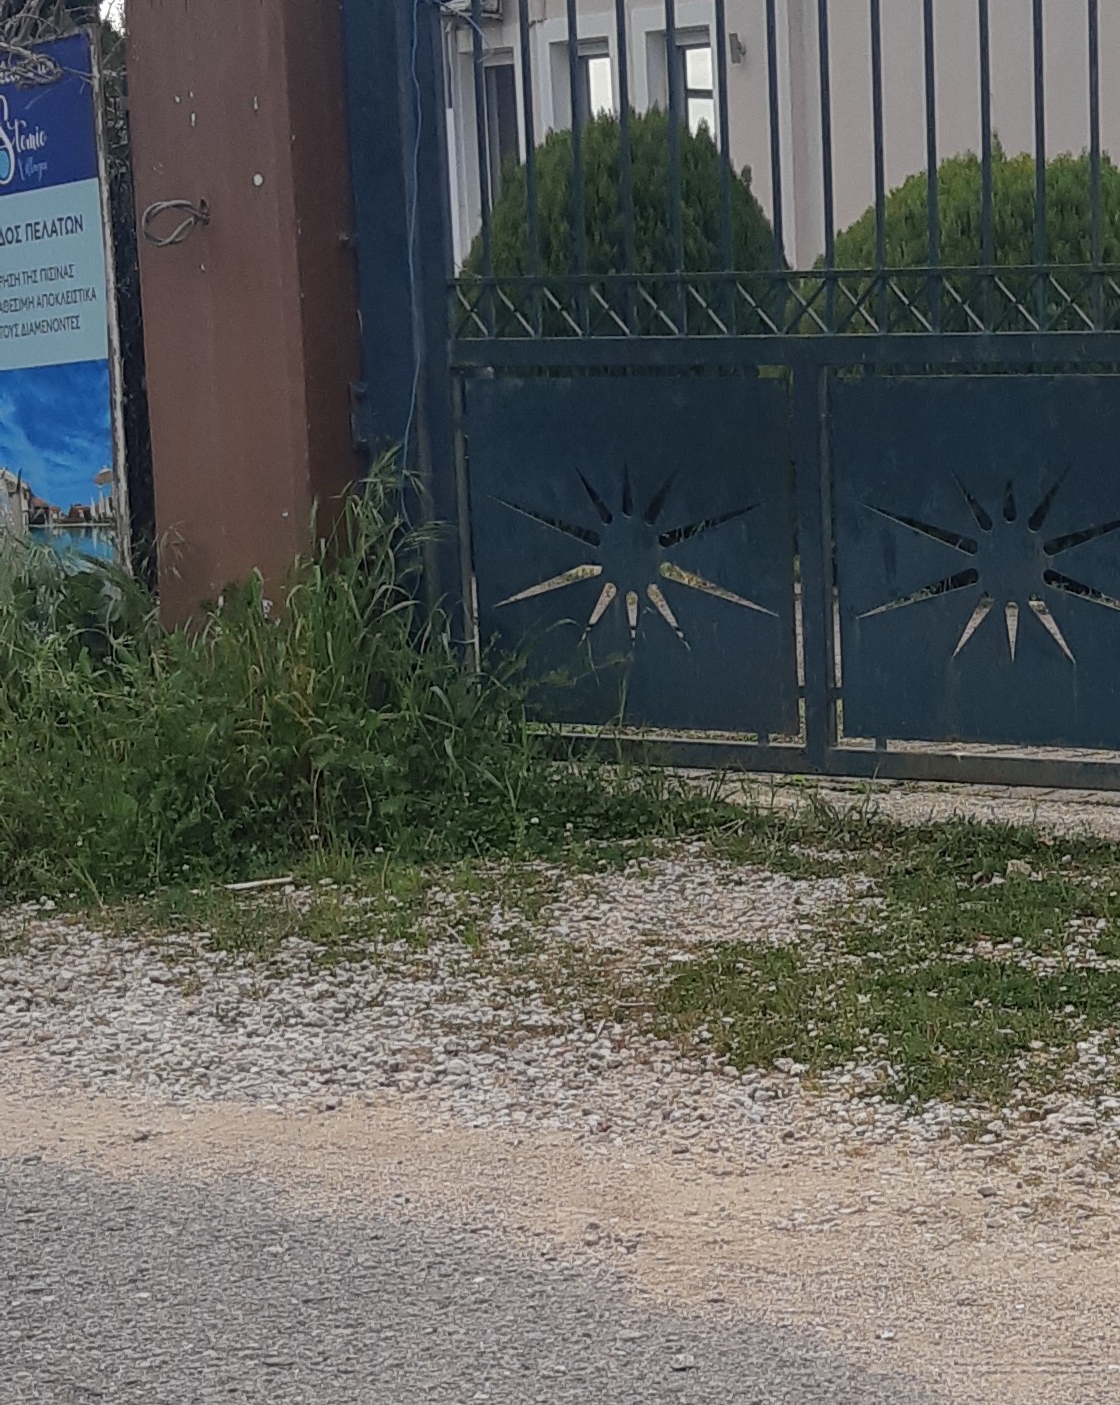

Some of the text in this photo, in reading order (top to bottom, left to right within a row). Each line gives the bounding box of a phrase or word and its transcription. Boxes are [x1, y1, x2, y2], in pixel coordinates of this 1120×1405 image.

[25, 213, 84, 242] ΠΕΛΑΤΩΝ
[22, 270, 38, 286] ΤΗΣ
[40, 263, 75, 283] ΠΙΣΙΝΑΣ
[37, 286, 97, 309] ΑΠΟΚΛΕΙΣΤΙΚΑ
[21, 314, 80, 337] ΔΙΑΜΕΝΟΝΤΕΣ
